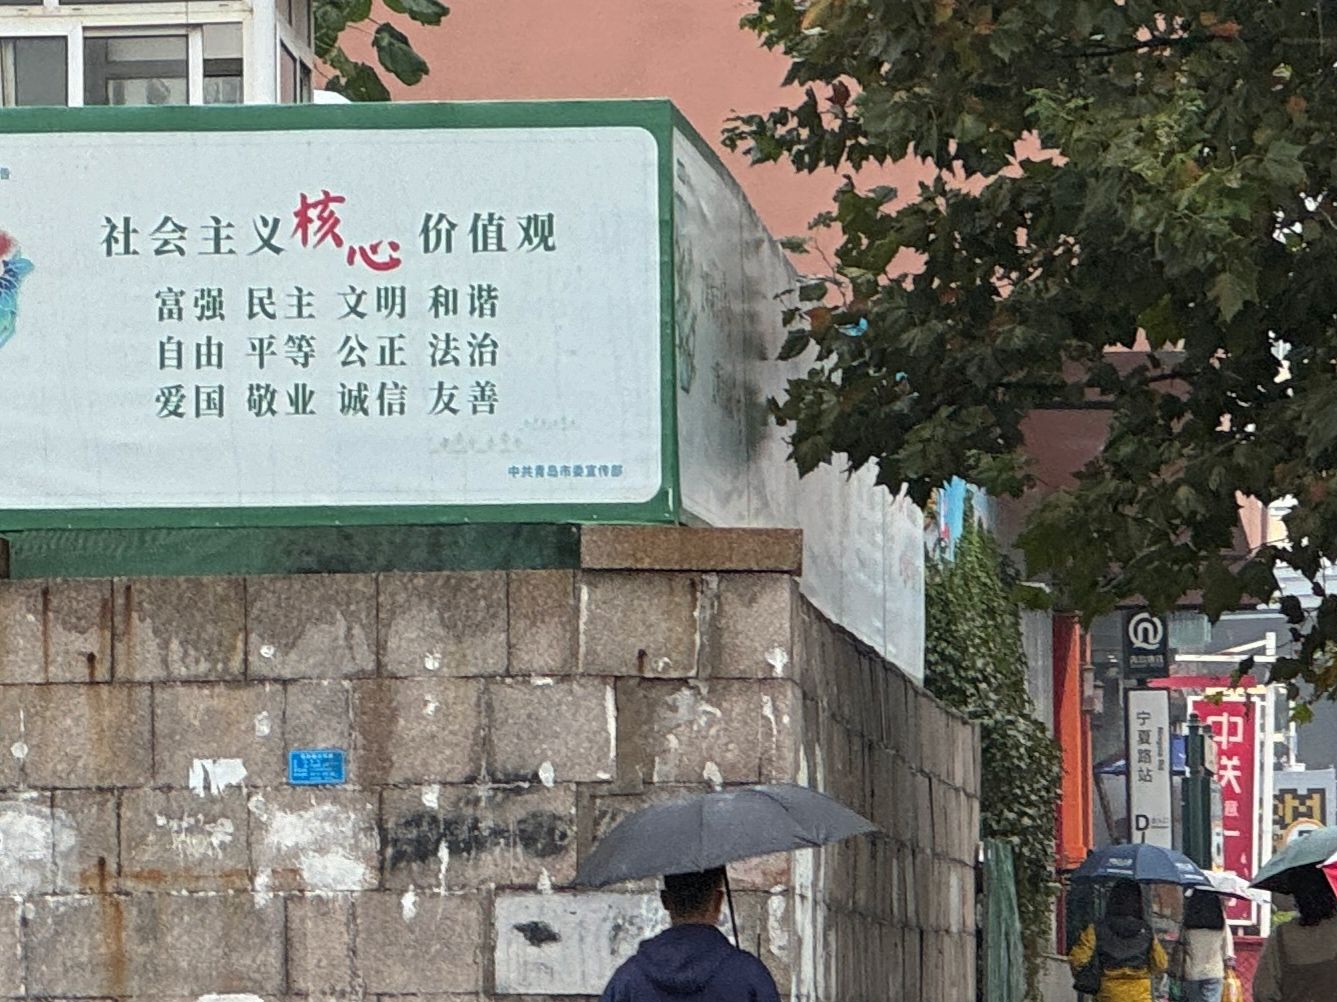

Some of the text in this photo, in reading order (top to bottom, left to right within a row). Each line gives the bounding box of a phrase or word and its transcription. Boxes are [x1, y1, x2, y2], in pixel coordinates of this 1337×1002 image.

[155, 284, 499, 322] 富强 民主 文明 和谐
[157, 333, 499, 370] 自由 平等 公正 法治
[155, 380, 499, 419] 爱国 敬业 诚信 友善
[507, 463, 623, 478] 中共青岛市委宣传部
